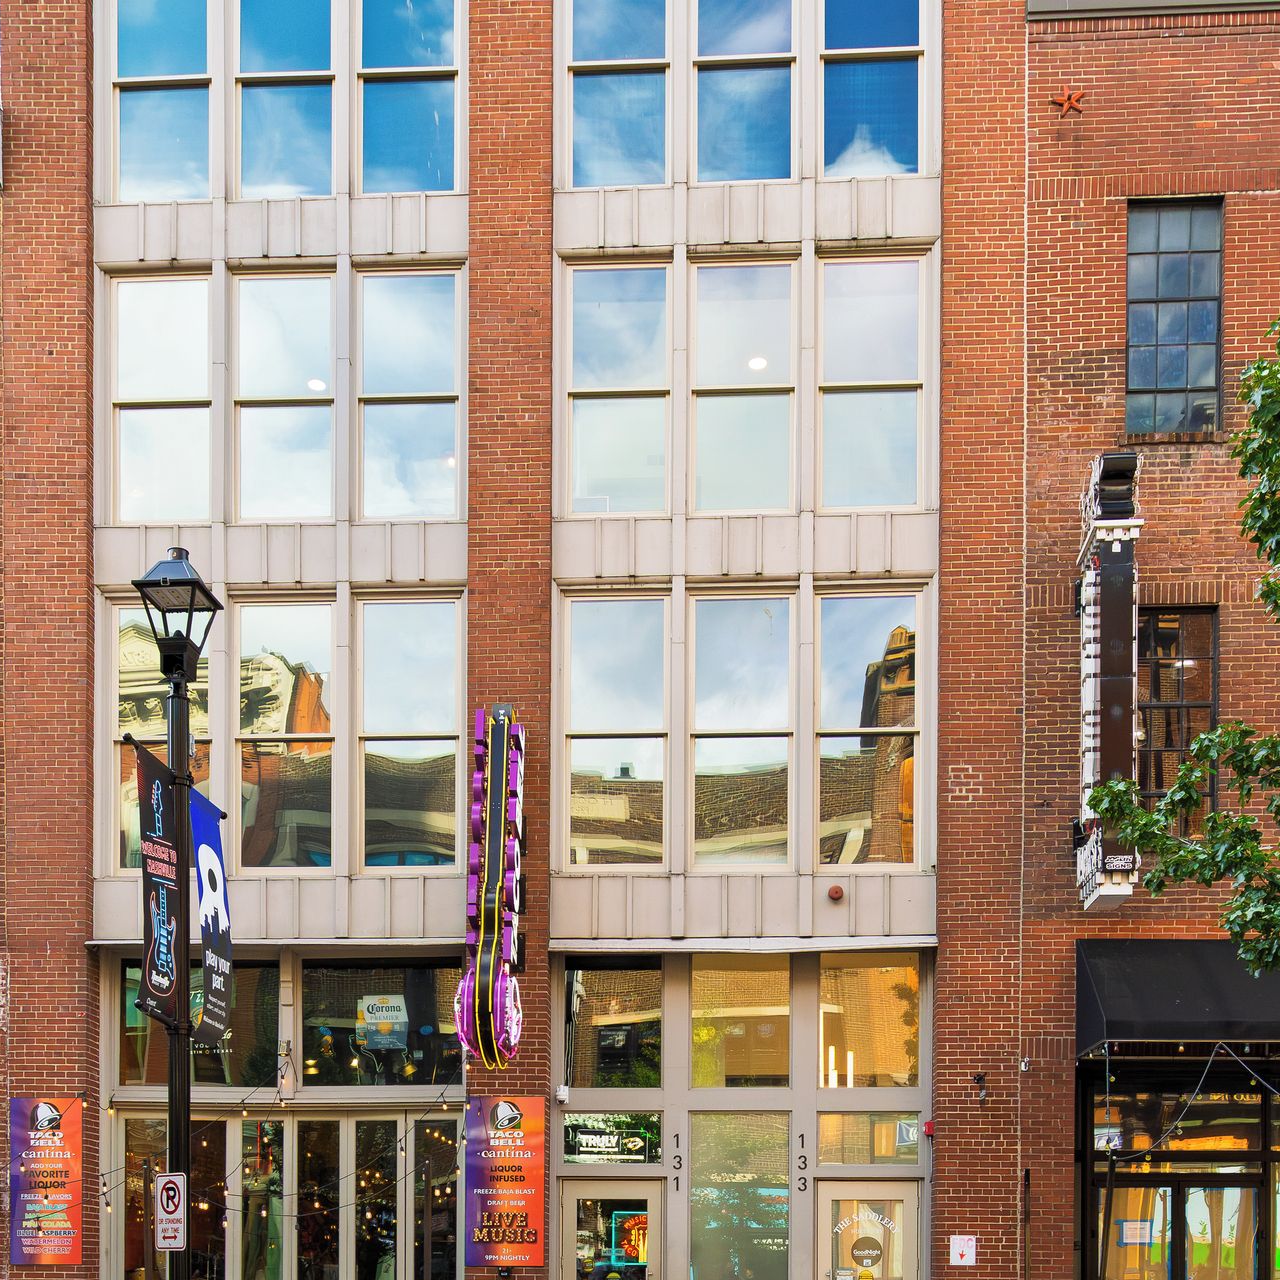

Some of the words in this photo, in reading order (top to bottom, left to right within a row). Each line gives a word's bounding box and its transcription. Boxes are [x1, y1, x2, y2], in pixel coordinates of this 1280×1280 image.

[205, 948, 218, 971] play
[218, 956, 231, 974] your
[212, 973, 225, 991] part.
[367, 1004, 402, 1014] Corona
[28, 1131, 64, 1139] TACO
[580, 1135, 618, 1147] TRULY
[22, 1147, 71, 1158] cantina
[481, 1146, 531, 1158] cantina
[25, 1170, 70, 1178] FAVORITE
[483, 1212, 527, 1226] LIVE
[834, 1217, 852, 1234] THE
[852, 1212, 900, 1234] SADDLERY
[473, 1228, 536, 1242] MUSIC
[621, 1240, 637, 1257] TACO
